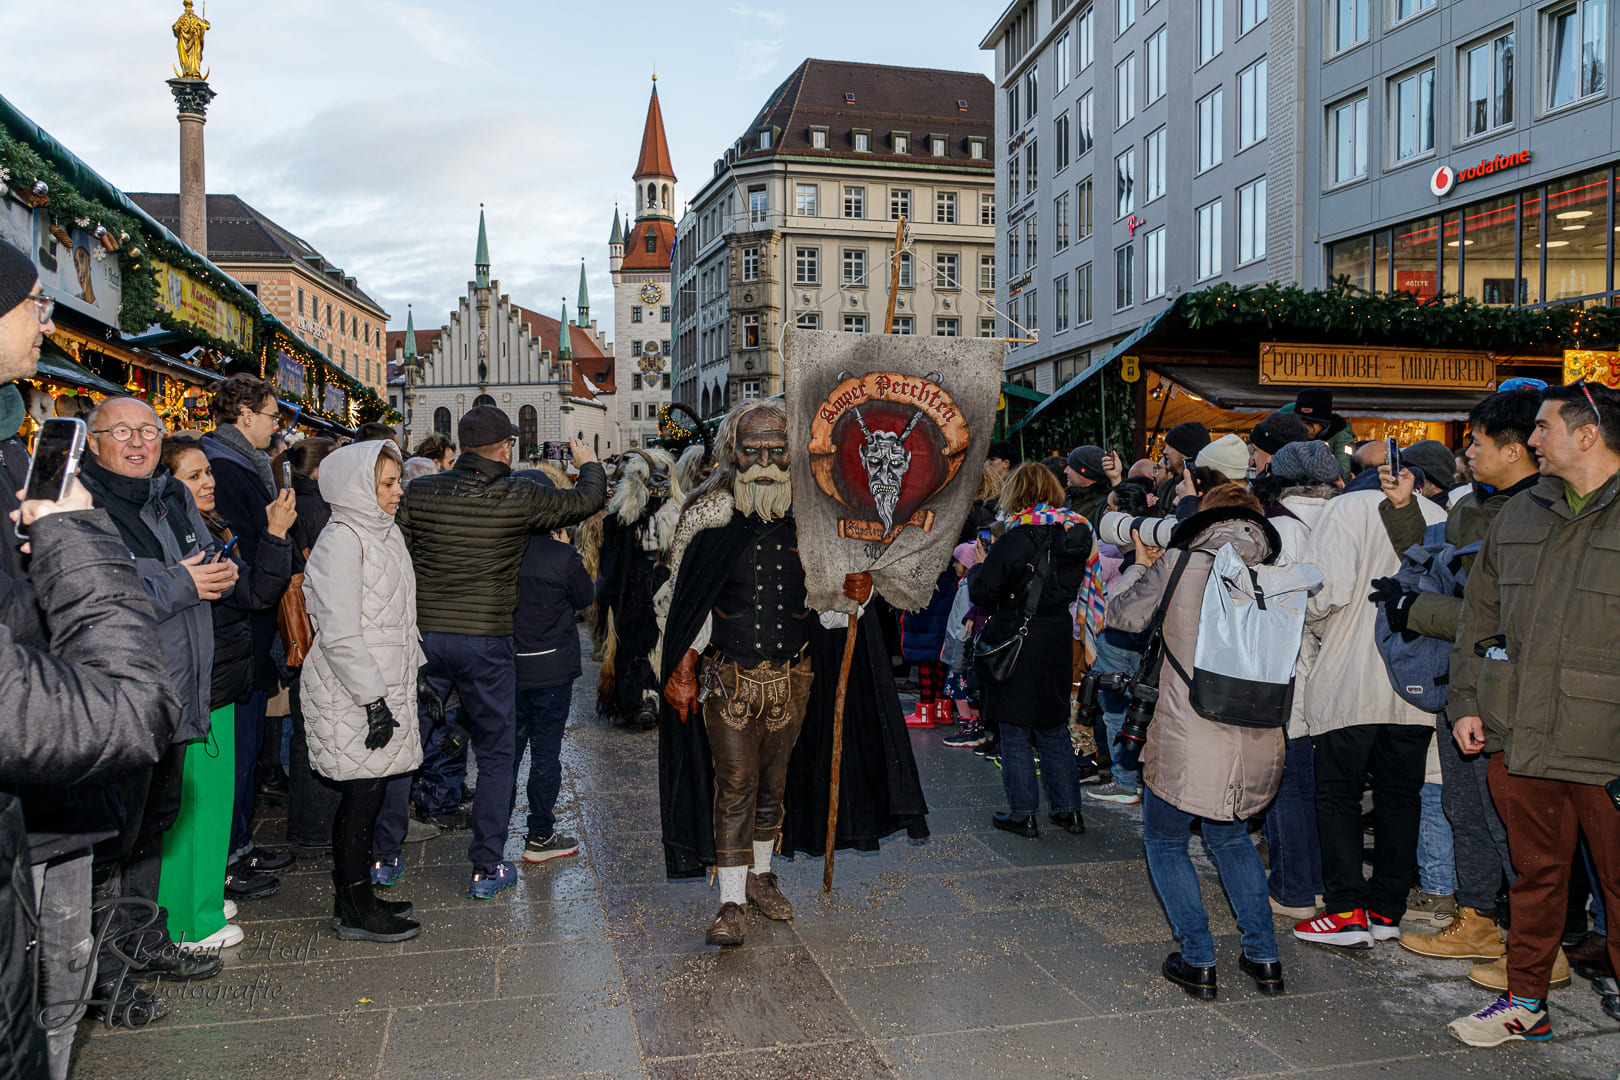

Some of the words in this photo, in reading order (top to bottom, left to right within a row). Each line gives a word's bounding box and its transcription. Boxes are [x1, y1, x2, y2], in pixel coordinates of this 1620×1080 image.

[1457, 149, 1530, 182] vodafone
[1272, 350, 1382, 379] PUPPENMÖBEL
[820, 383, 867, 424] Amper
[875, 375, 957, 423] Perchten
